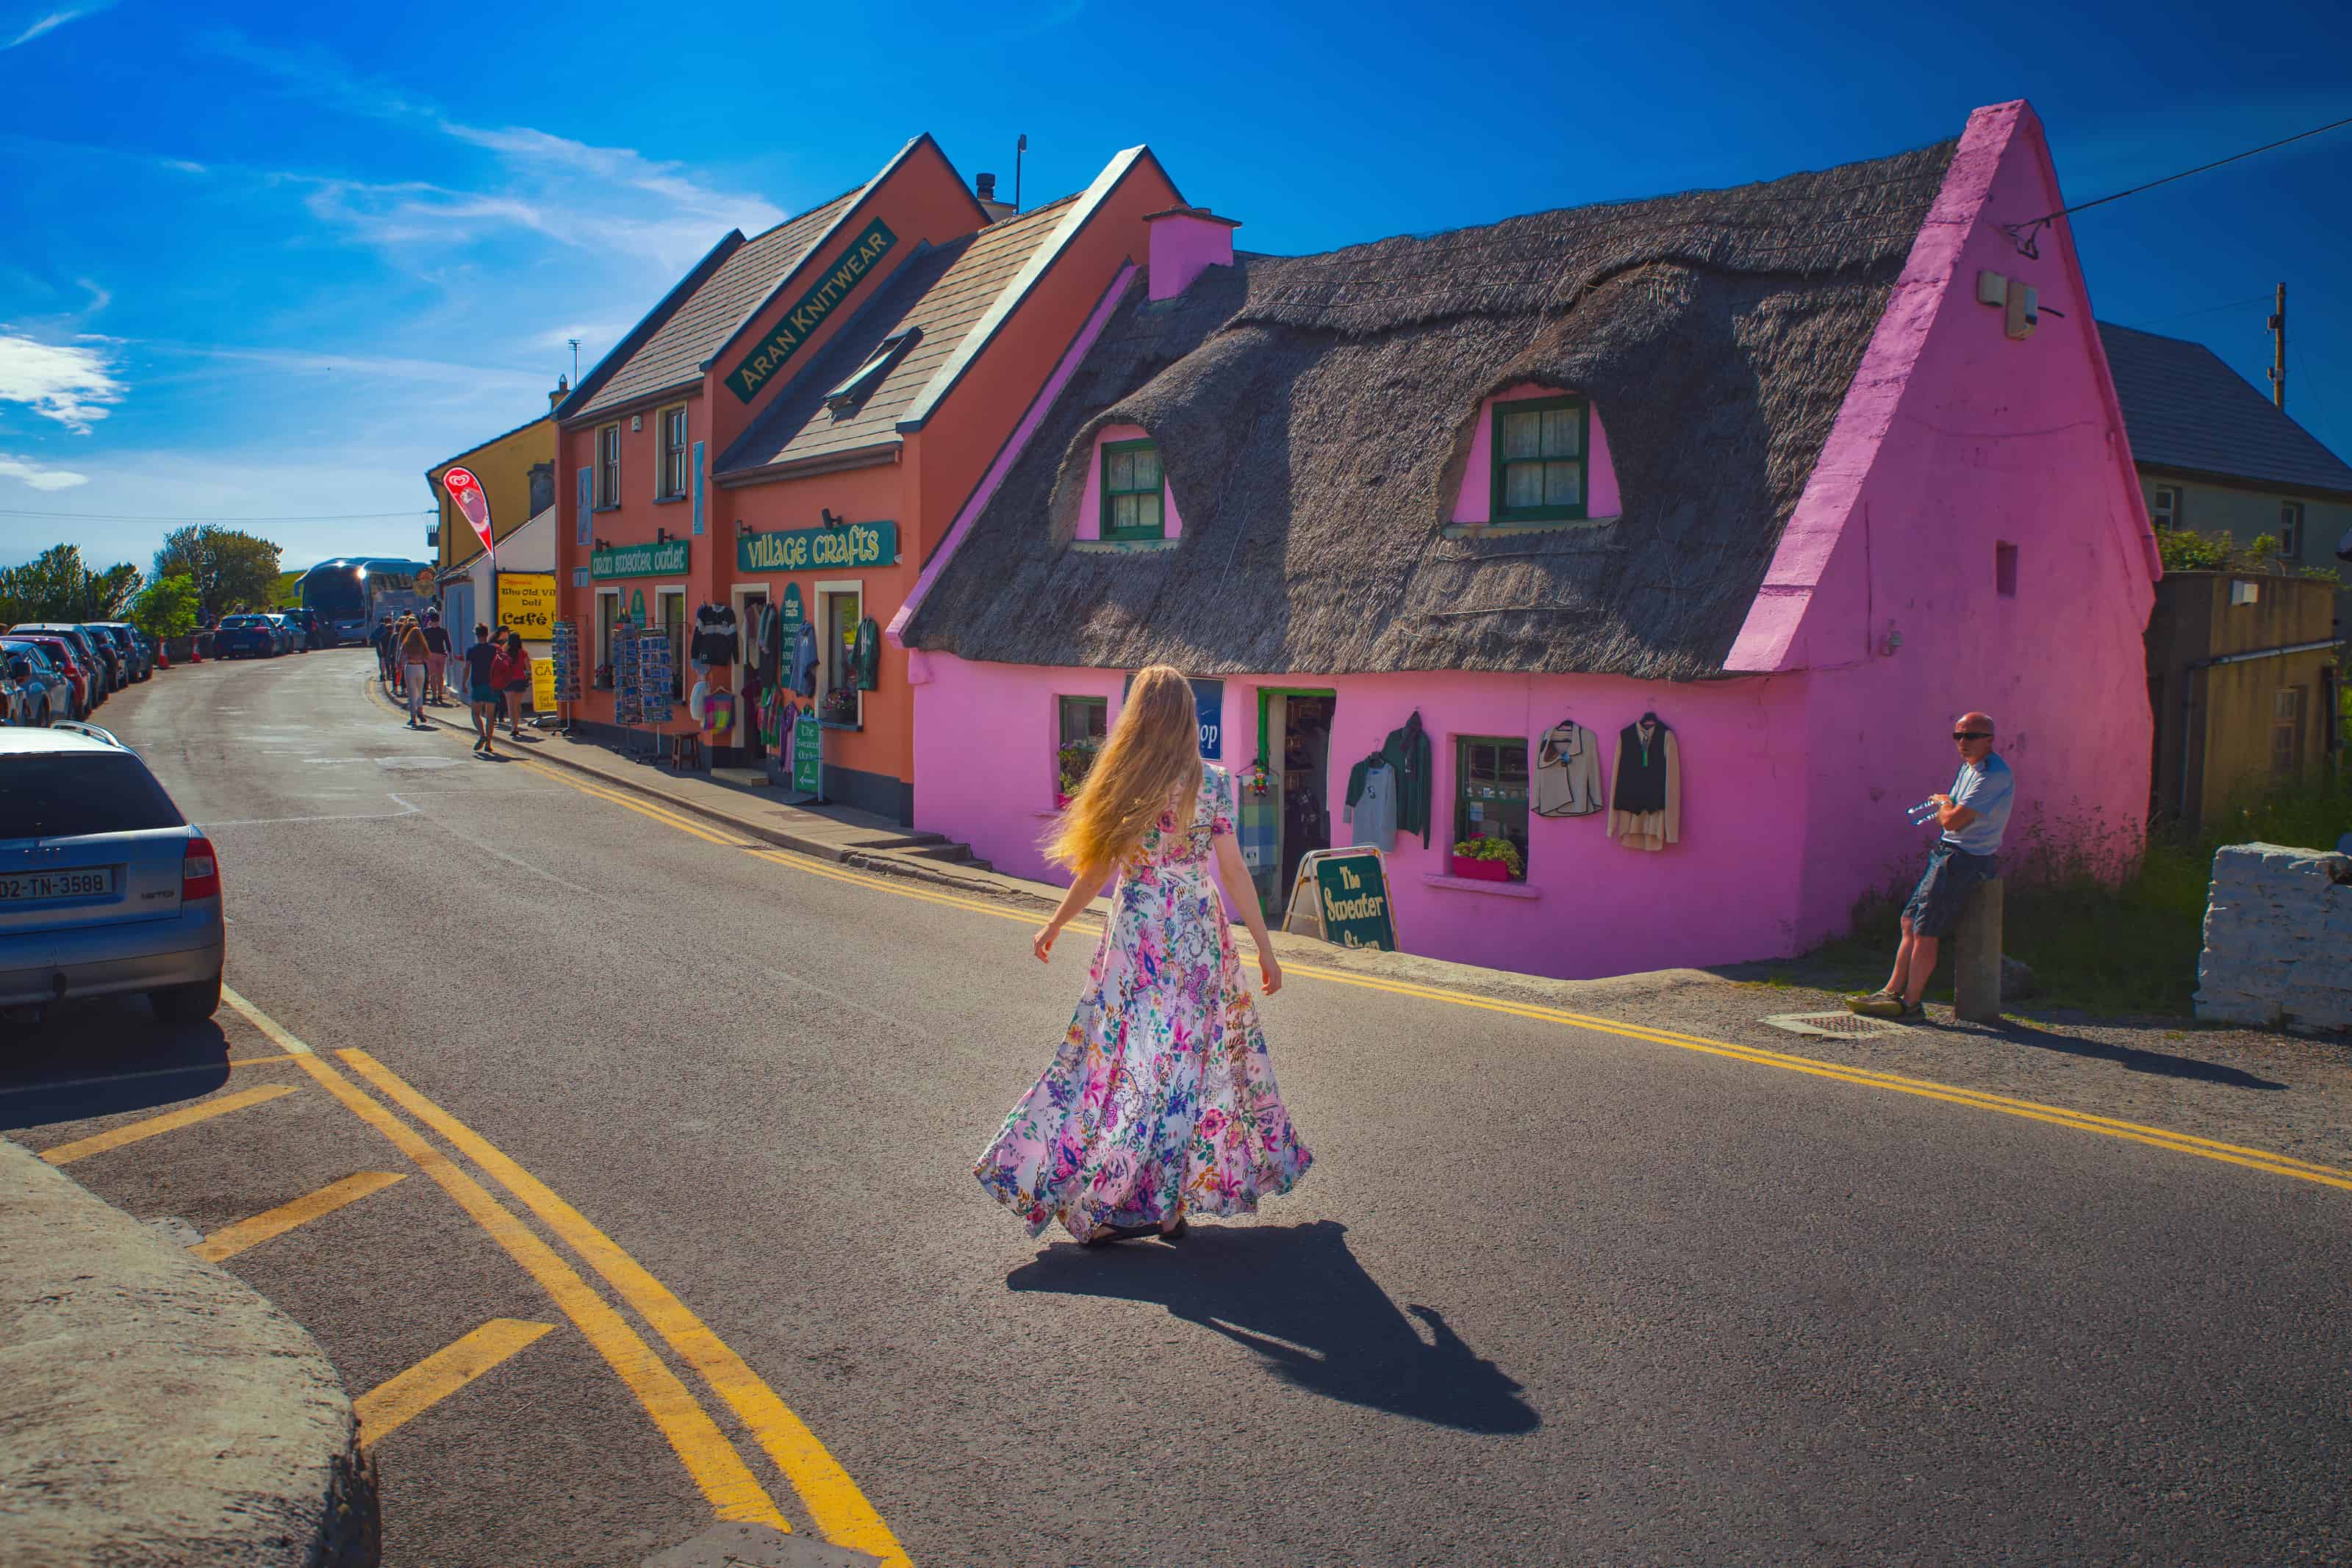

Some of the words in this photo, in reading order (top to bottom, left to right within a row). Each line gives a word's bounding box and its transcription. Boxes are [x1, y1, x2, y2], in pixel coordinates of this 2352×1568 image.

[741, 328, 797, 391] ARAN
[790, 232, 887, 334] KNITWEAR
[615, 550, 651, 572] sweater
[654, 544, 684, 571] outlet
[502, 612, 548, 626] Café
[535, 666, 553, 676] CA
[1200, 724, 1218, 749] op
[1339, 866, 1361, 890] The
[1324, 887, 1384, 922] Sweater
